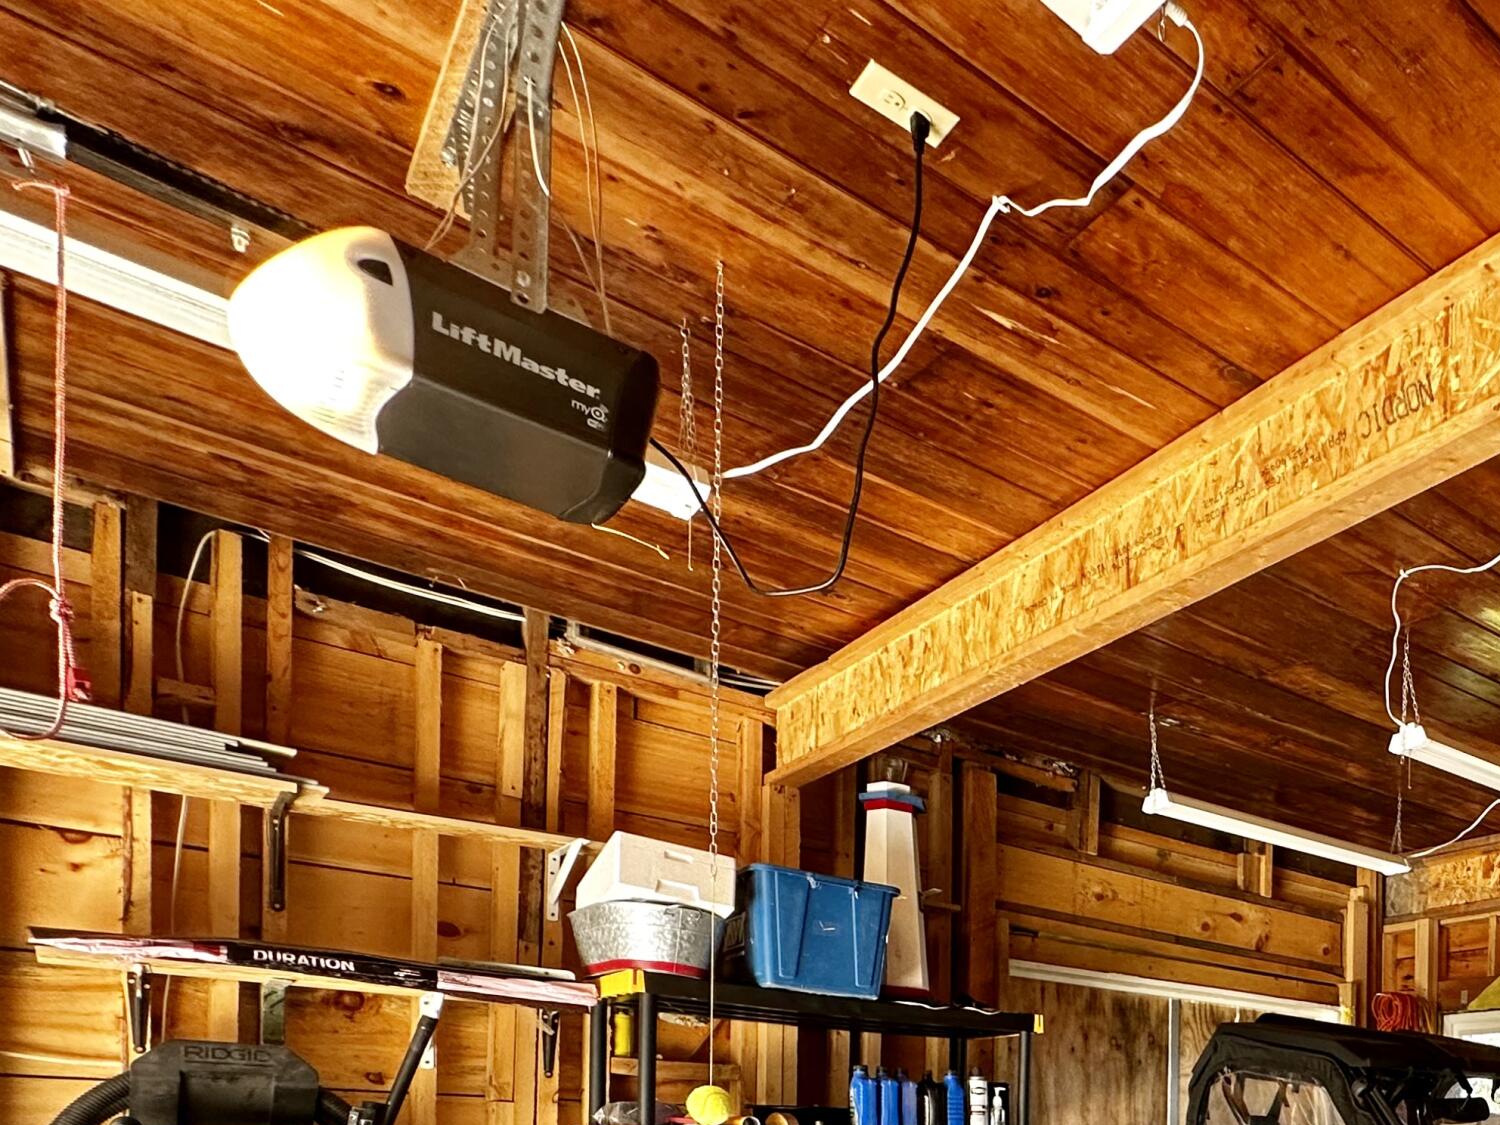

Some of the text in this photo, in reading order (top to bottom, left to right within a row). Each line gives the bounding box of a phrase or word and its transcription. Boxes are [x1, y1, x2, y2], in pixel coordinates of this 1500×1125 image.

[432, 311, 600, 399] LiftMaster
[1357, 373, 1435, 439] NORDIC
[252, 949, 355, 971] DURATION
[183, 1045, 274, 1063] RIDGID
